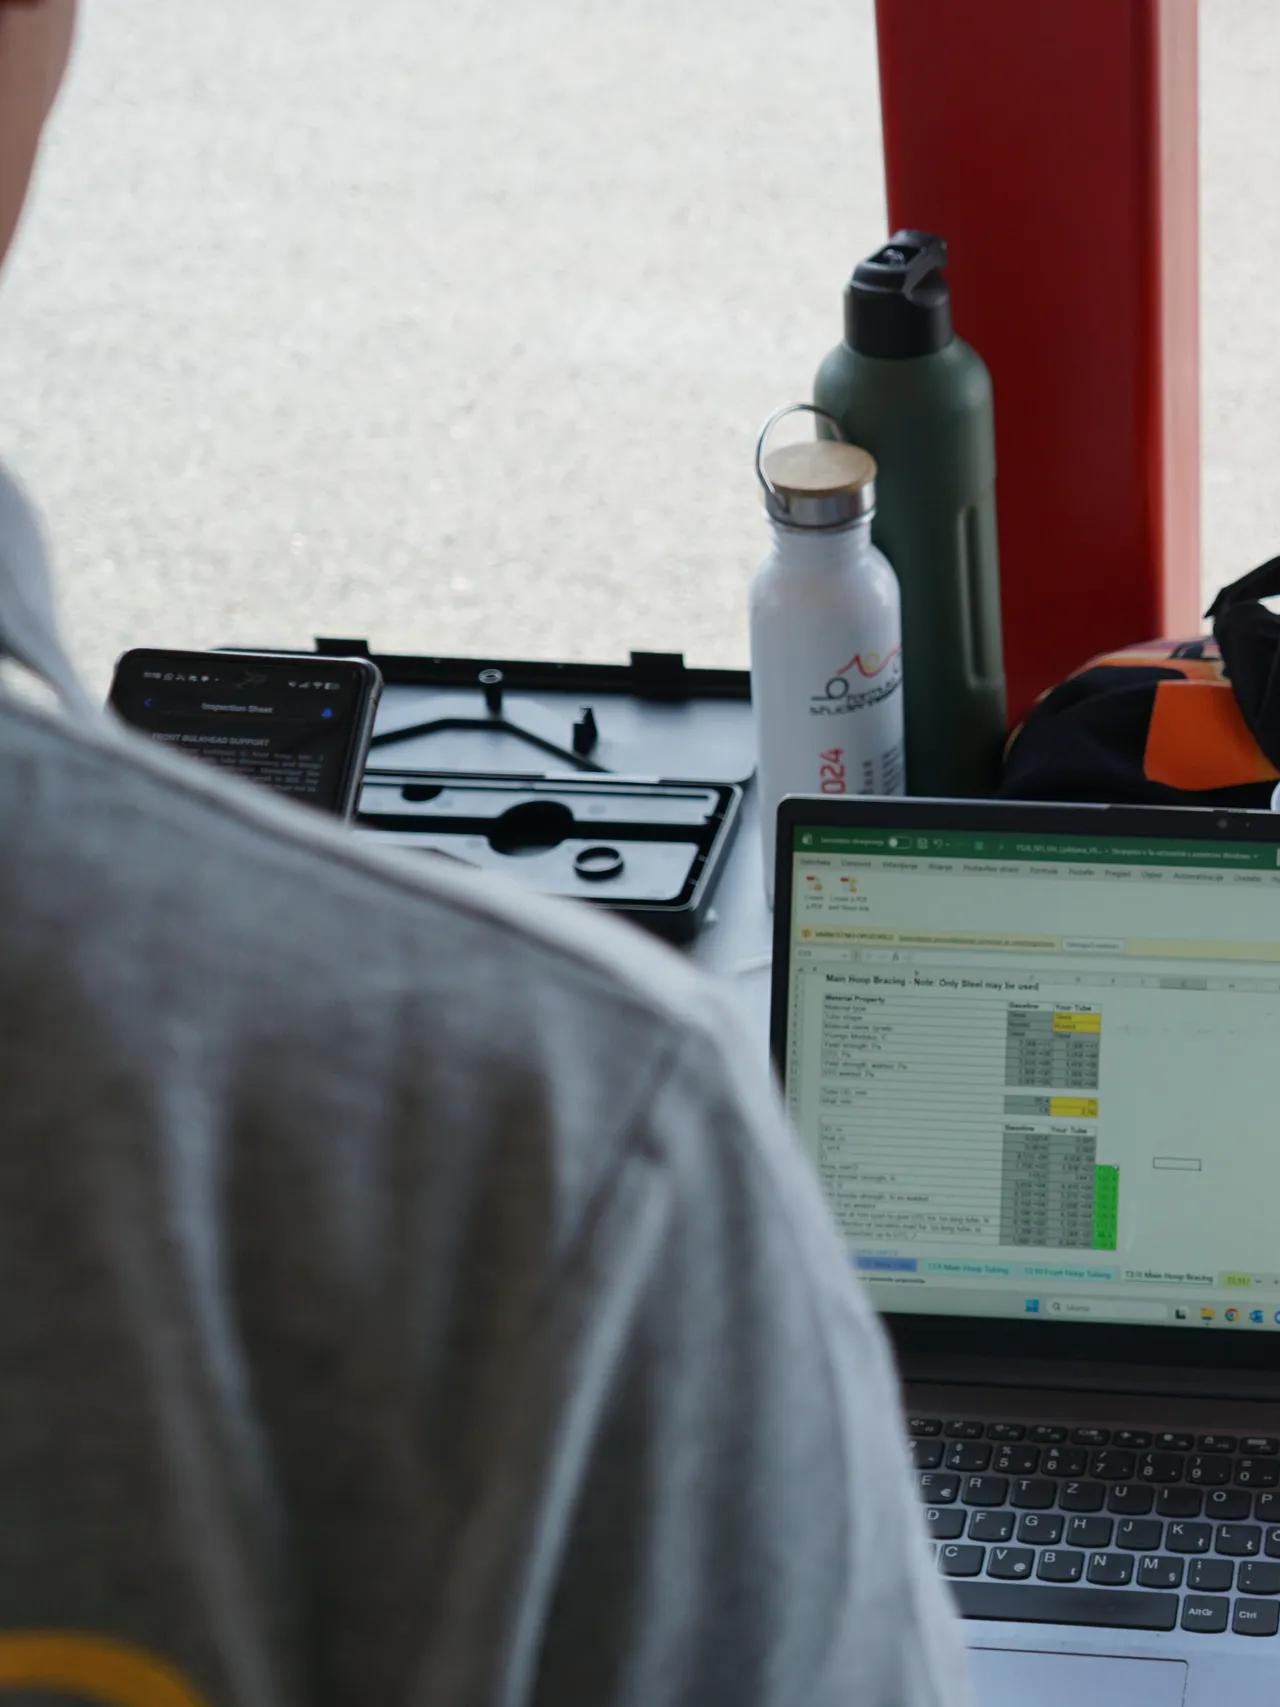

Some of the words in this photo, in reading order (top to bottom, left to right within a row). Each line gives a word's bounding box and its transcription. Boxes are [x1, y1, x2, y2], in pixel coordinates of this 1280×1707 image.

[201, 702, 247, 712] Inspection
[248, 705, 273, 714] Sheet
[152, 733, 181, 742] FRONT
[182, 734, 228, 744] BULKHEAD
[229, 737, 270, 747] SUPPORT
[826, 974, 847, 984] Main
[849, 976, 871, 987] Hoop
[874, 977, 906, 987] Bracing
[914, 978, 936, 987] Note:
[939, 979, 959, 990] Only
[962, 980, 983, 989] Steel
[984, 983, 1003, 992] may
[1005, 982, 1016, 991] be
[1018, 982, 1040, 992] used
[854, 996, 886, 1004] Property
[984, 1266, 1010, 1275] Tubing
[1144, 1272, 1164, 1280] Main
[1166, 1273, 1185, 1282] Hoop
[1186, 1274, 1214, 1284] Bracing
[952, 1455, 960, 1465] 4
[1000, 1457, 1009, 1468] 5
[1047, 1460, 1057, 1470] 6
[1095, 1463, 1106, 1473] 7
[1143, 1466, 1153, 1476] 8
[1192, 1468, 1202, 1478] 9
[921, 1475, 933, 1486] E
[970, 1478, 982, 1488] R
[1020, 1480, 1031, 1491] T
[1066, 1483, 1079, 1494] Z
[1115, 1486, 1128, 1497] U
[1212, 1491, 1227, 1502] O
[1261, 1494, 1273, 1504] P
[927, 1510, 940, 1521] D
[976, 1513, 987, 1524] F
[1025, 1516, 1039, 1526] G
[1074, 1518, 1087, 1530] H
[1124, 1522, 1134, 1532] J
[1172, 1524, 1184, 1535] K
[1222, 1528, 1231, 1538] L
[945, 1546, 959, 1558] C
[996, 1550, 1008, 1560] V
[1044, 1552, 1056, 1564] B
[1094, 1556, 1108, 1566] N
[1013, 1562, 1027, 1573] @
[1144, 1558, 1160, 1570] M
[1188, 1608, 1214, 1617] AltGr
[1238, 1610, 1258, 1620] Ctrl
